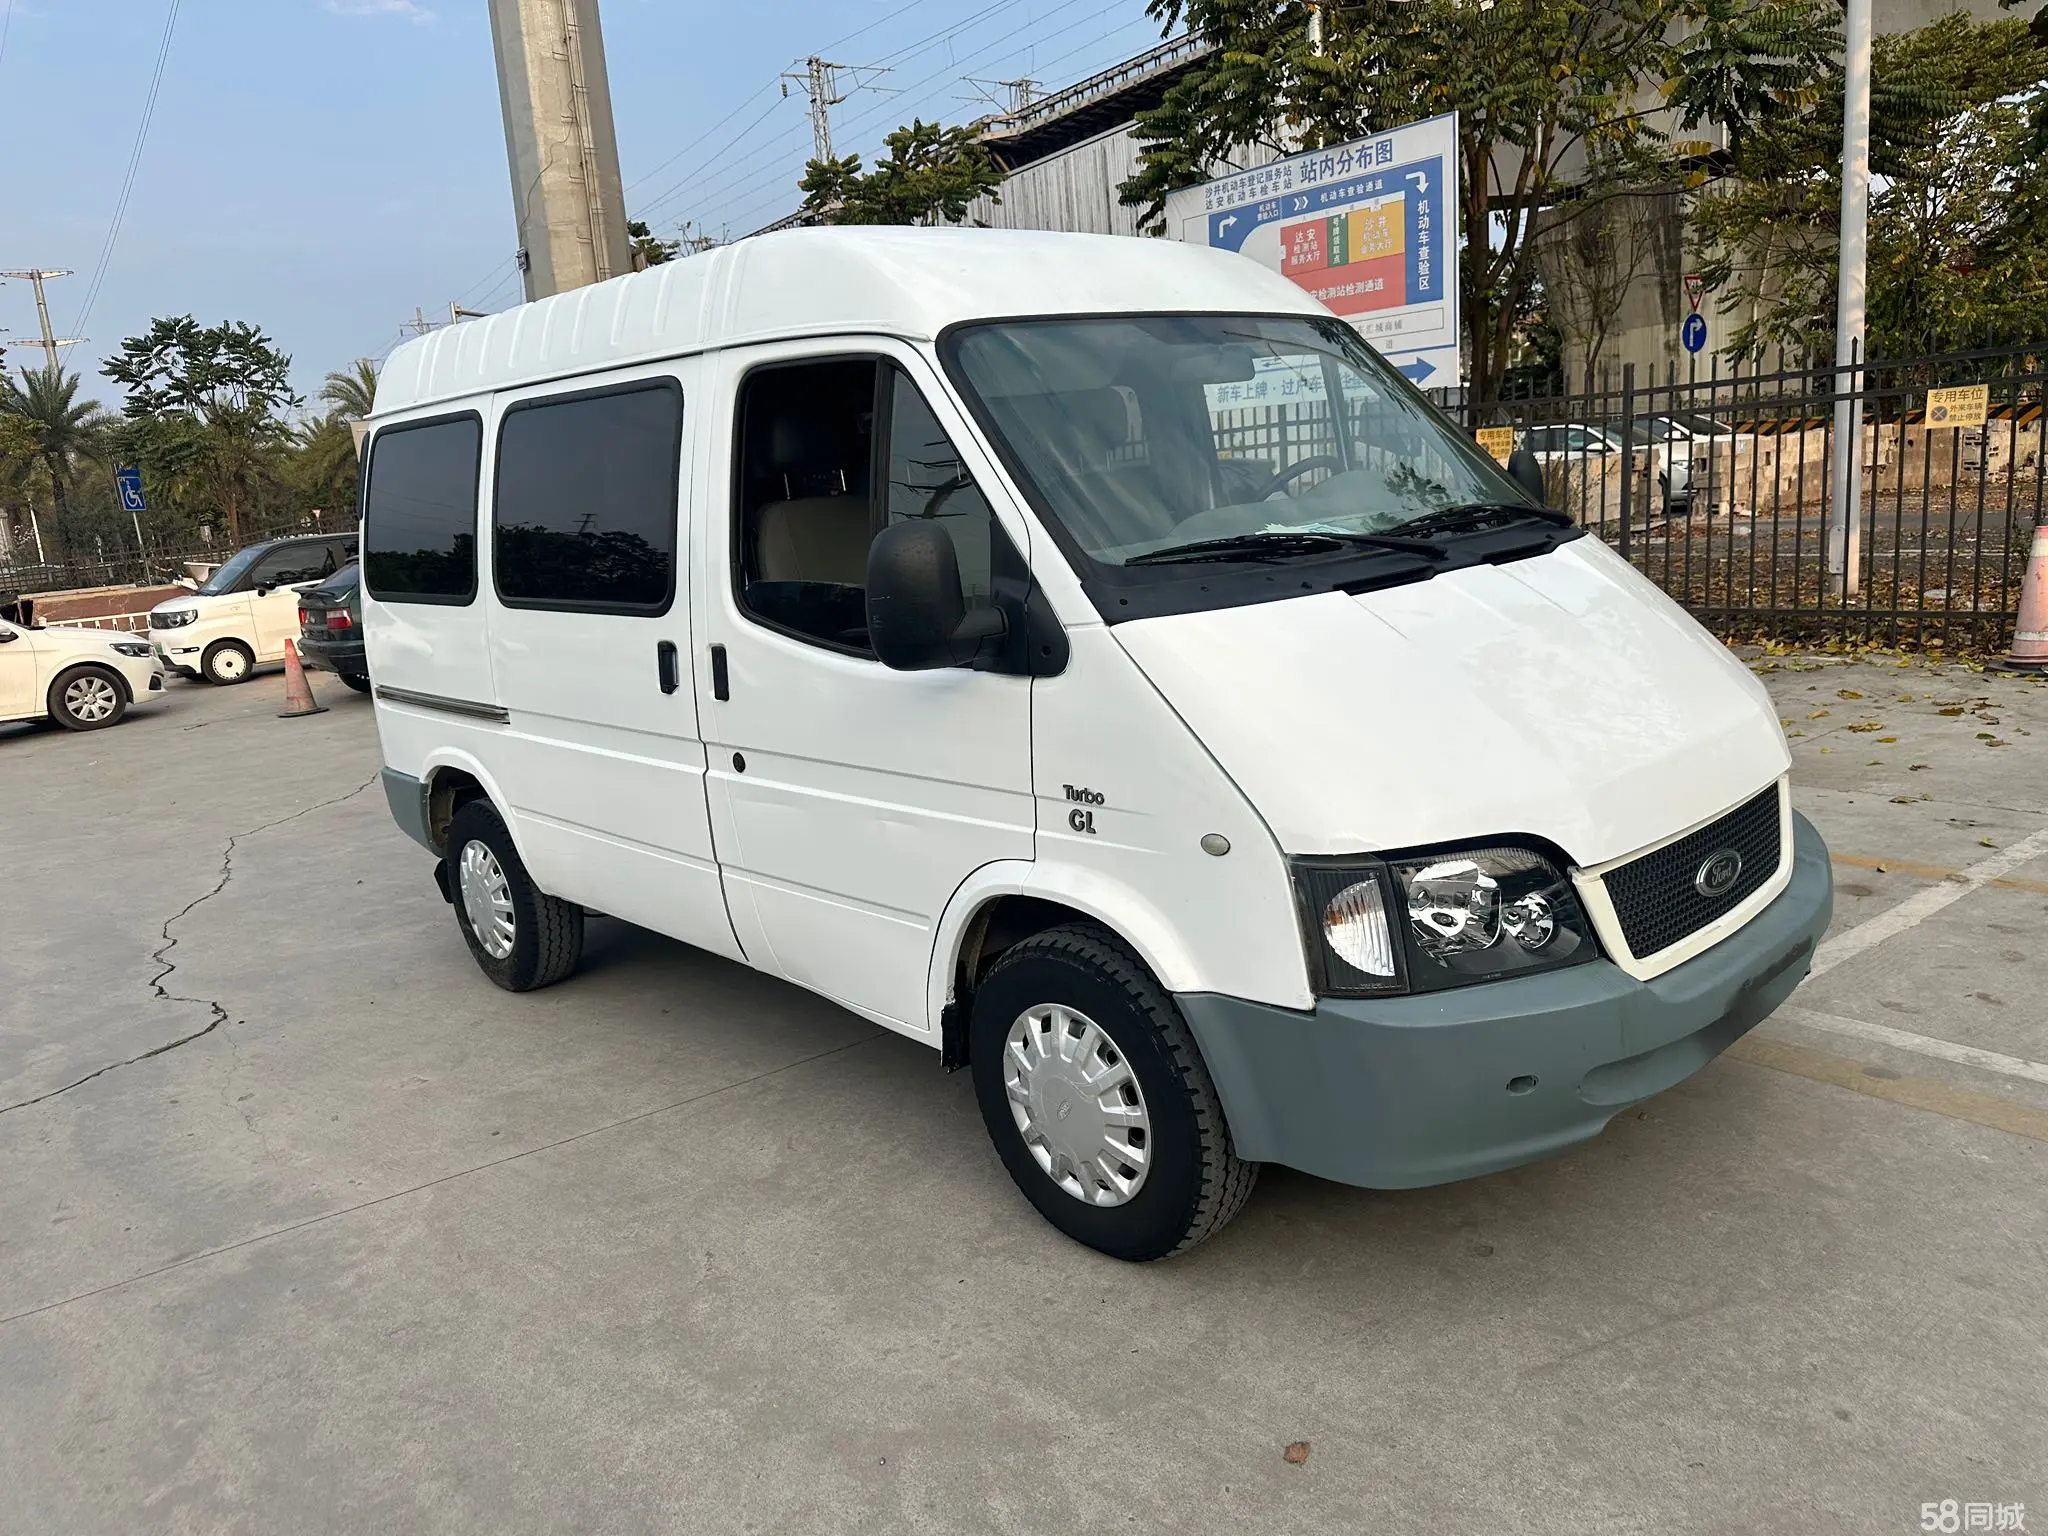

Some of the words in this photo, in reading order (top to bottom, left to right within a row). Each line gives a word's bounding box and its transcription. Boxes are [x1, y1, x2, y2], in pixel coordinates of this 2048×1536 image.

[1300, 138, 1392, 183] 站内分布图
[1205, 164, 1292, 198] 沙井机动车登记服务站
[1320, 179, 1383, 202] 机动车查验通道
[1295, 228, 1316, 243] 达安
[1417, 199, 1430, 290] 机动车查验区
[1931, 387, 1983, 403] 专用车位
[1063, 784, 1105, 805] Turbo
[1068, 808, 1096, 834] GL
